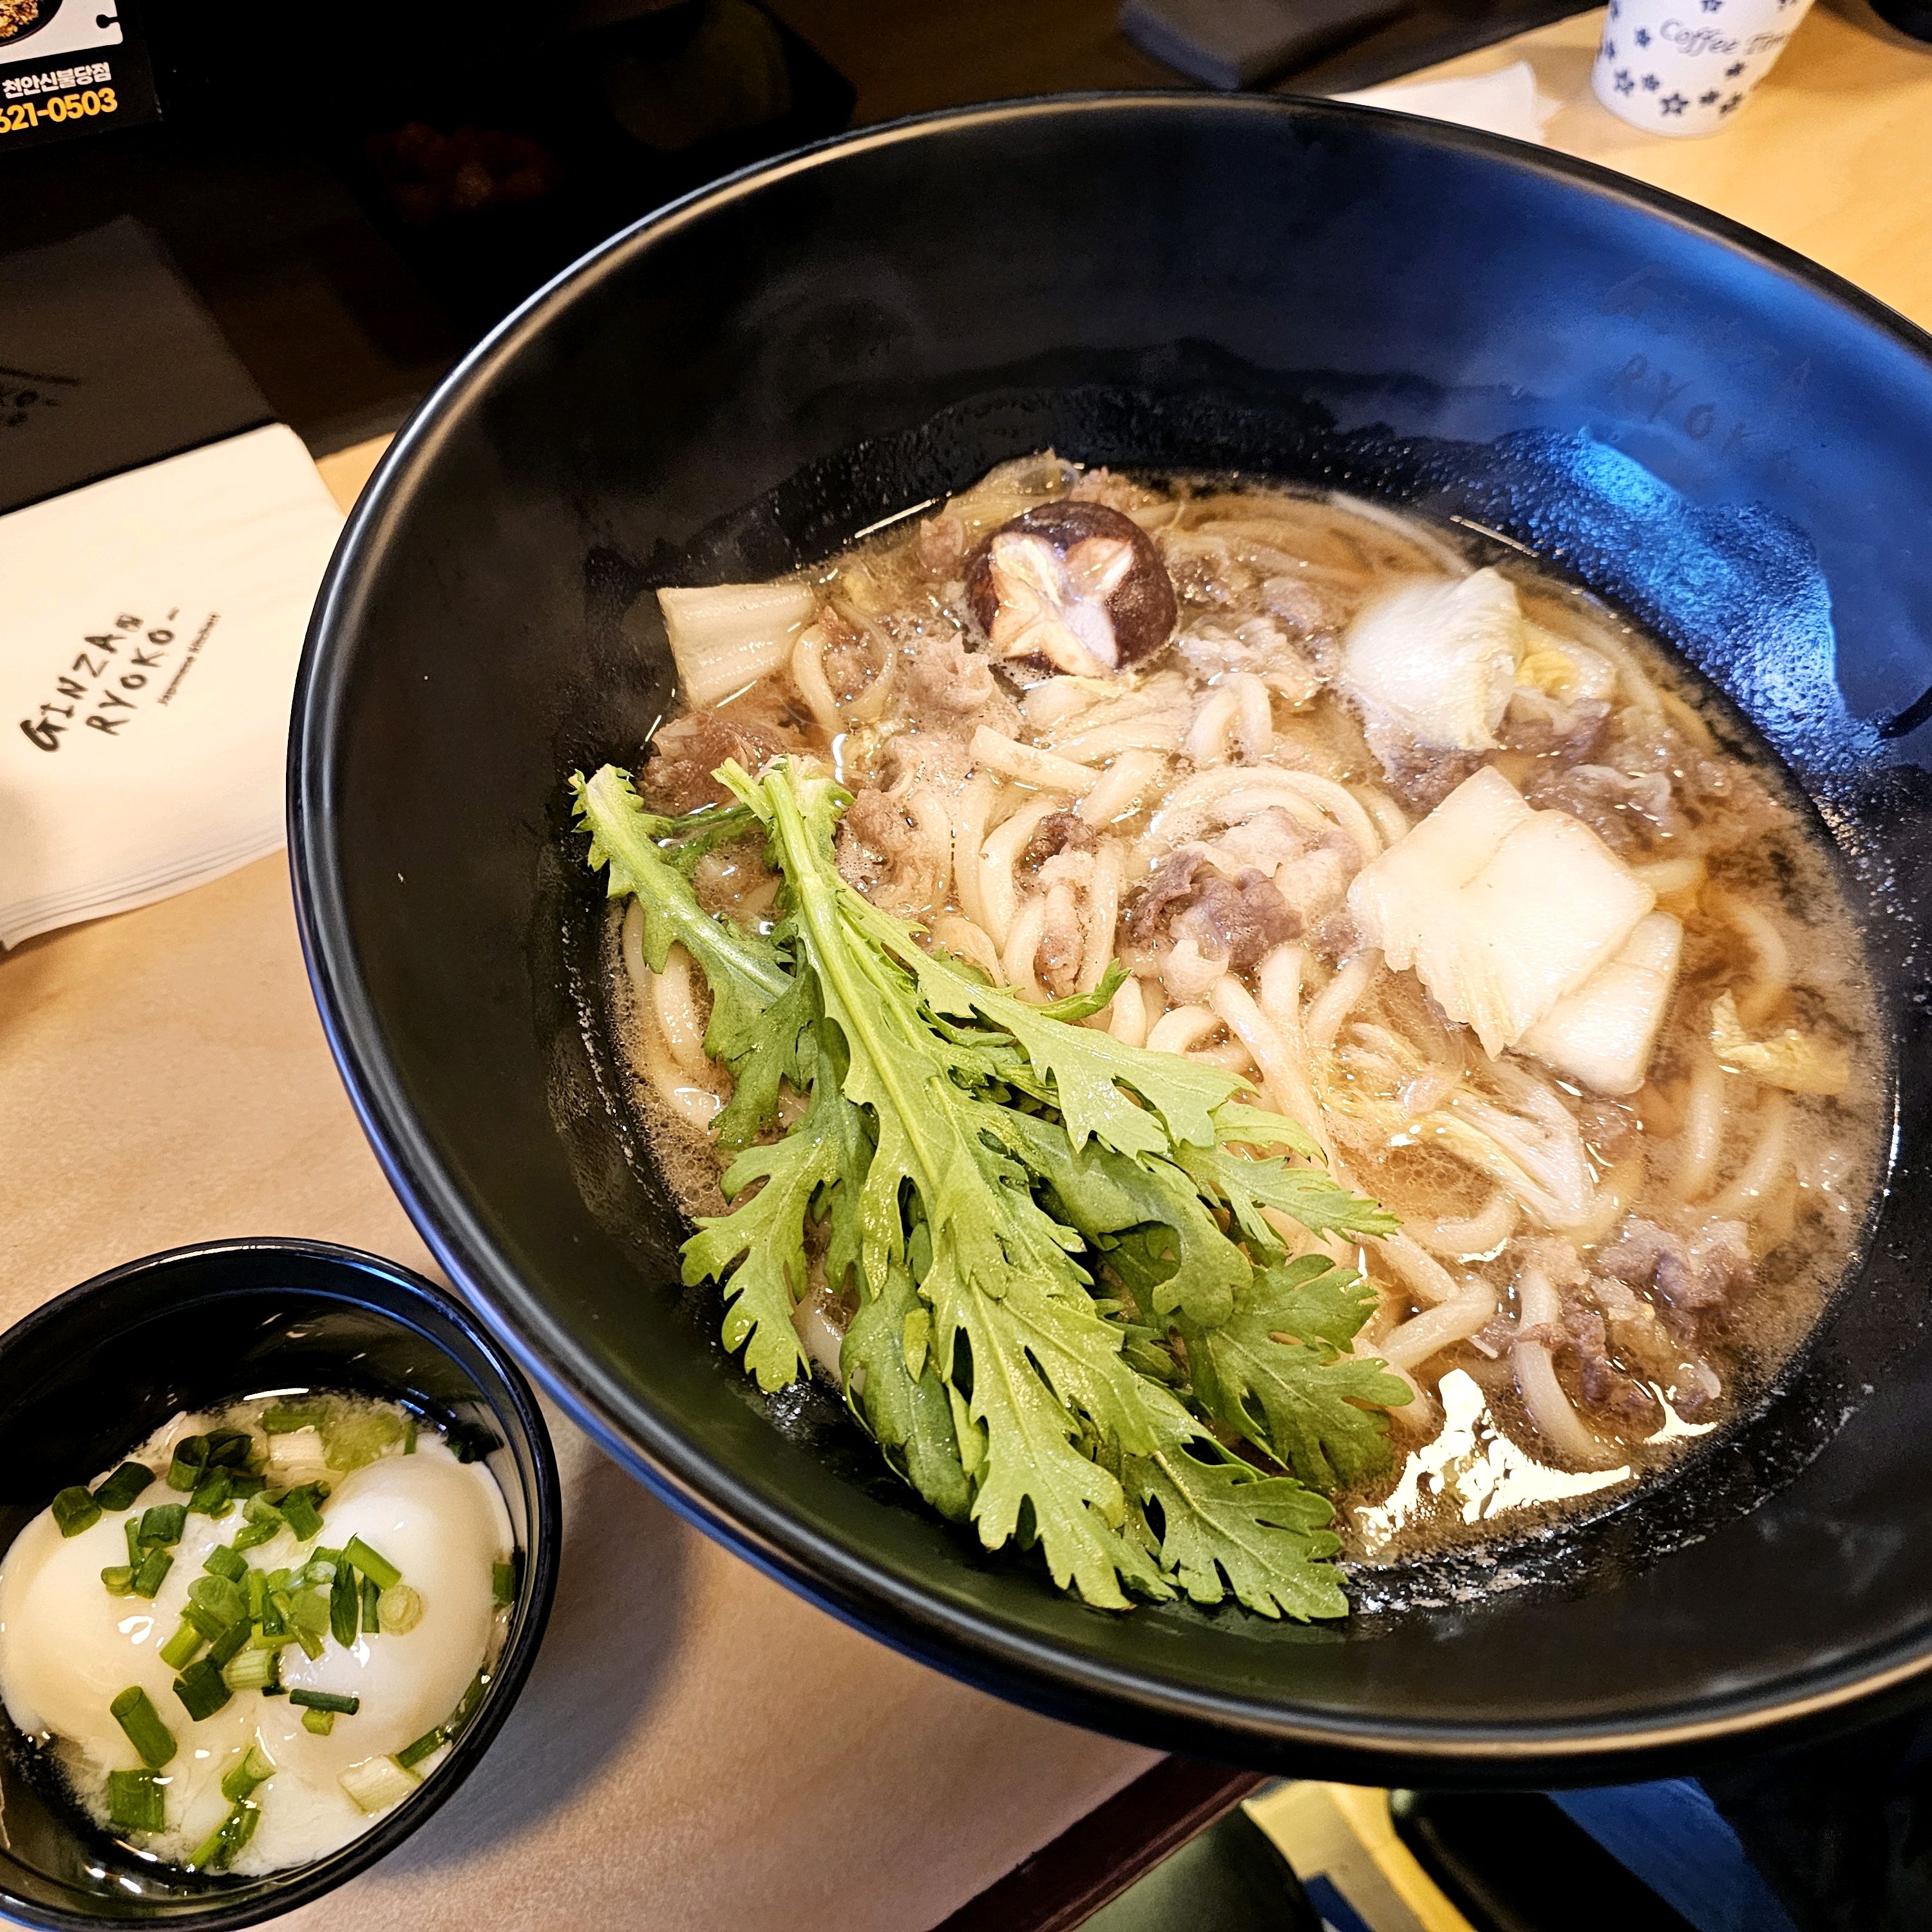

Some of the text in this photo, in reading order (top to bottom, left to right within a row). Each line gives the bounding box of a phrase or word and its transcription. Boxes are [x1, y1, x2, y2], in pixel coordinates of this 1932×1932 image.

[1660, 19, 1738, 57] Coffee
[2, 62, 111, 99] 천안신불당점
[0, 87, 118, 133] 621-0503
